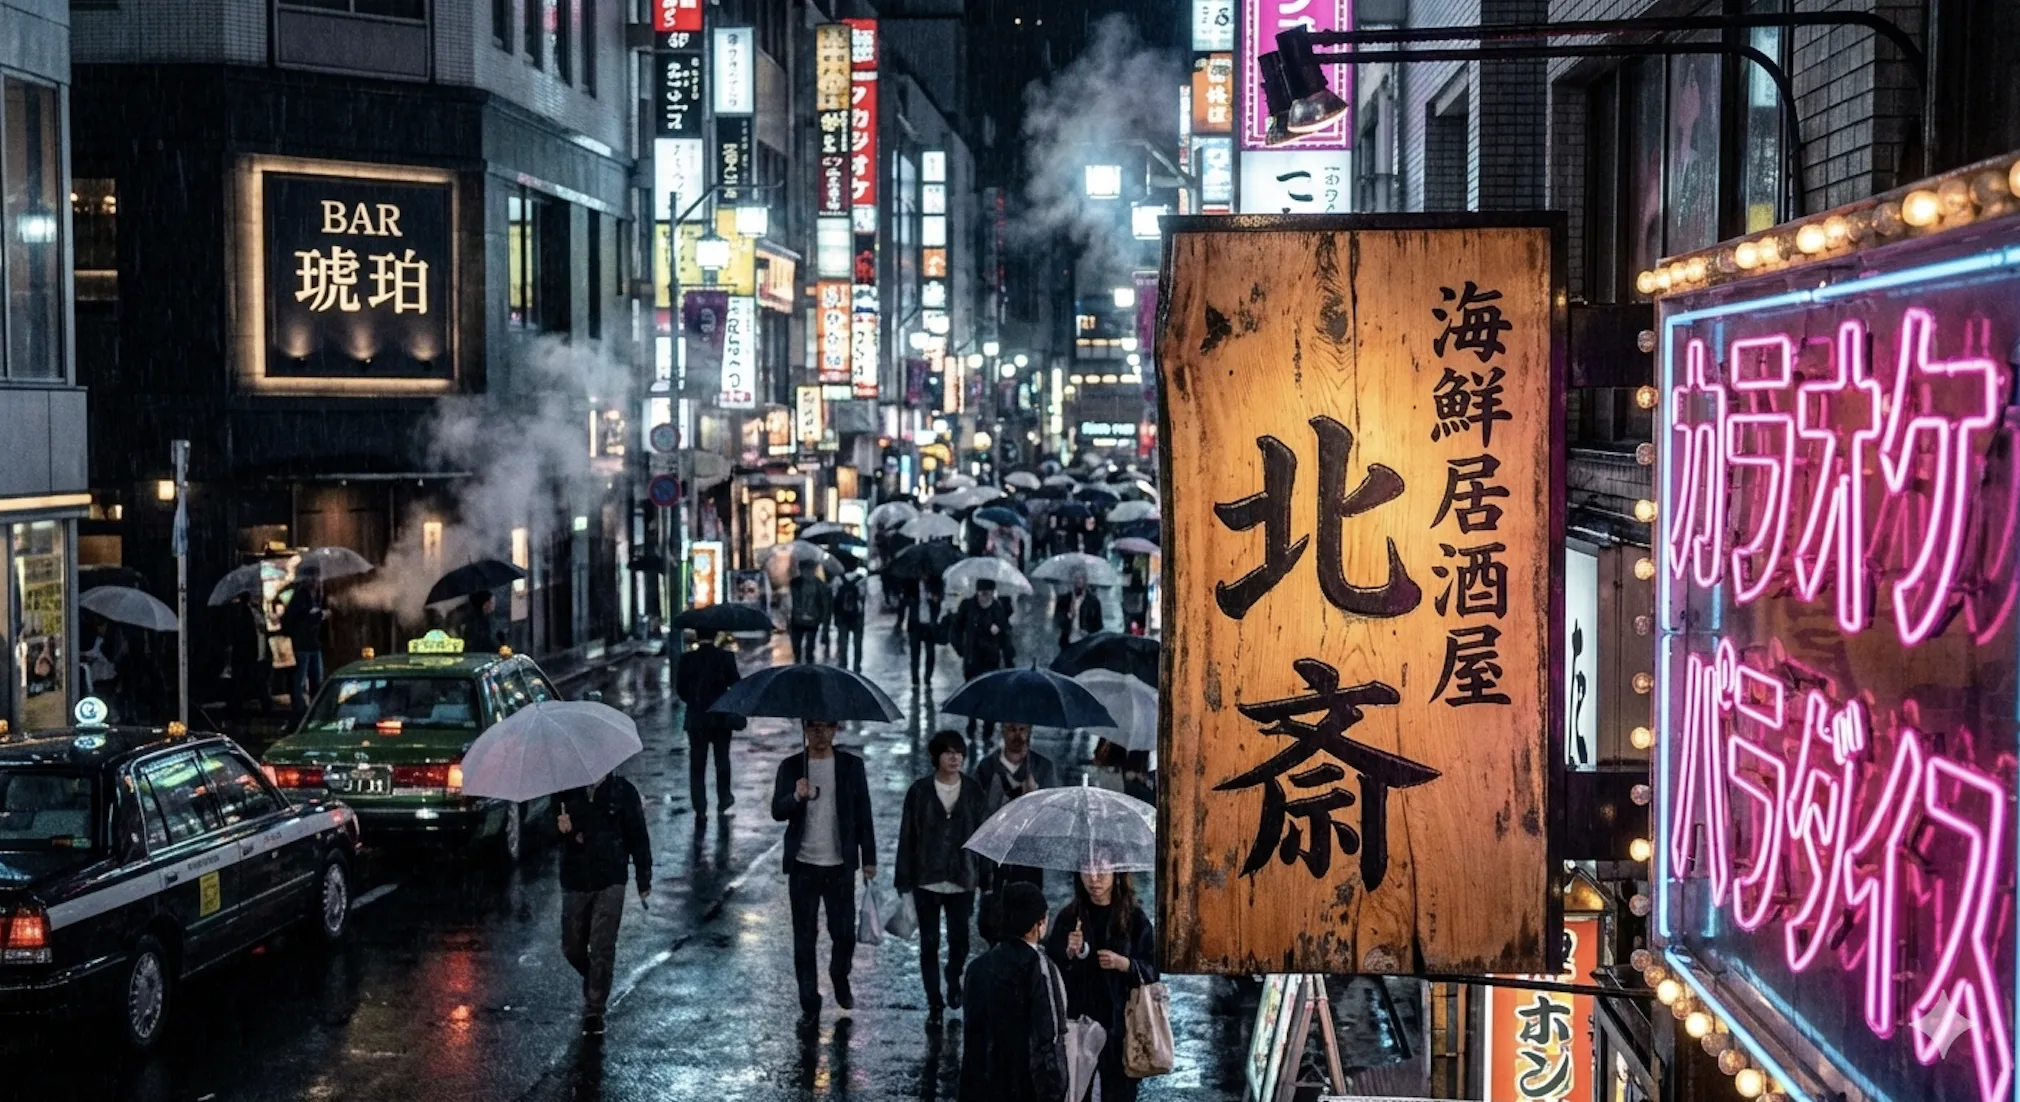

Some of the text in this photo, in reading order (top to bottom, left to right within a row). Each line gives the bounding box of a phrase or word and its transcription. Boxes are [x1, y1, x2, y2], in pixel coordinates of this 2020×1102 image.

[294, 245, 429, 314] 琥珀
[321, 200, 403, 237] BAR
[1213, 414, 1442, 893] 北斎
[1428, 280, 1513, 708] 海鮮居酒屋
[1669, 306, 1998, 648] カラオケ
[1670, 636, 2014, 1102] パラダイス
